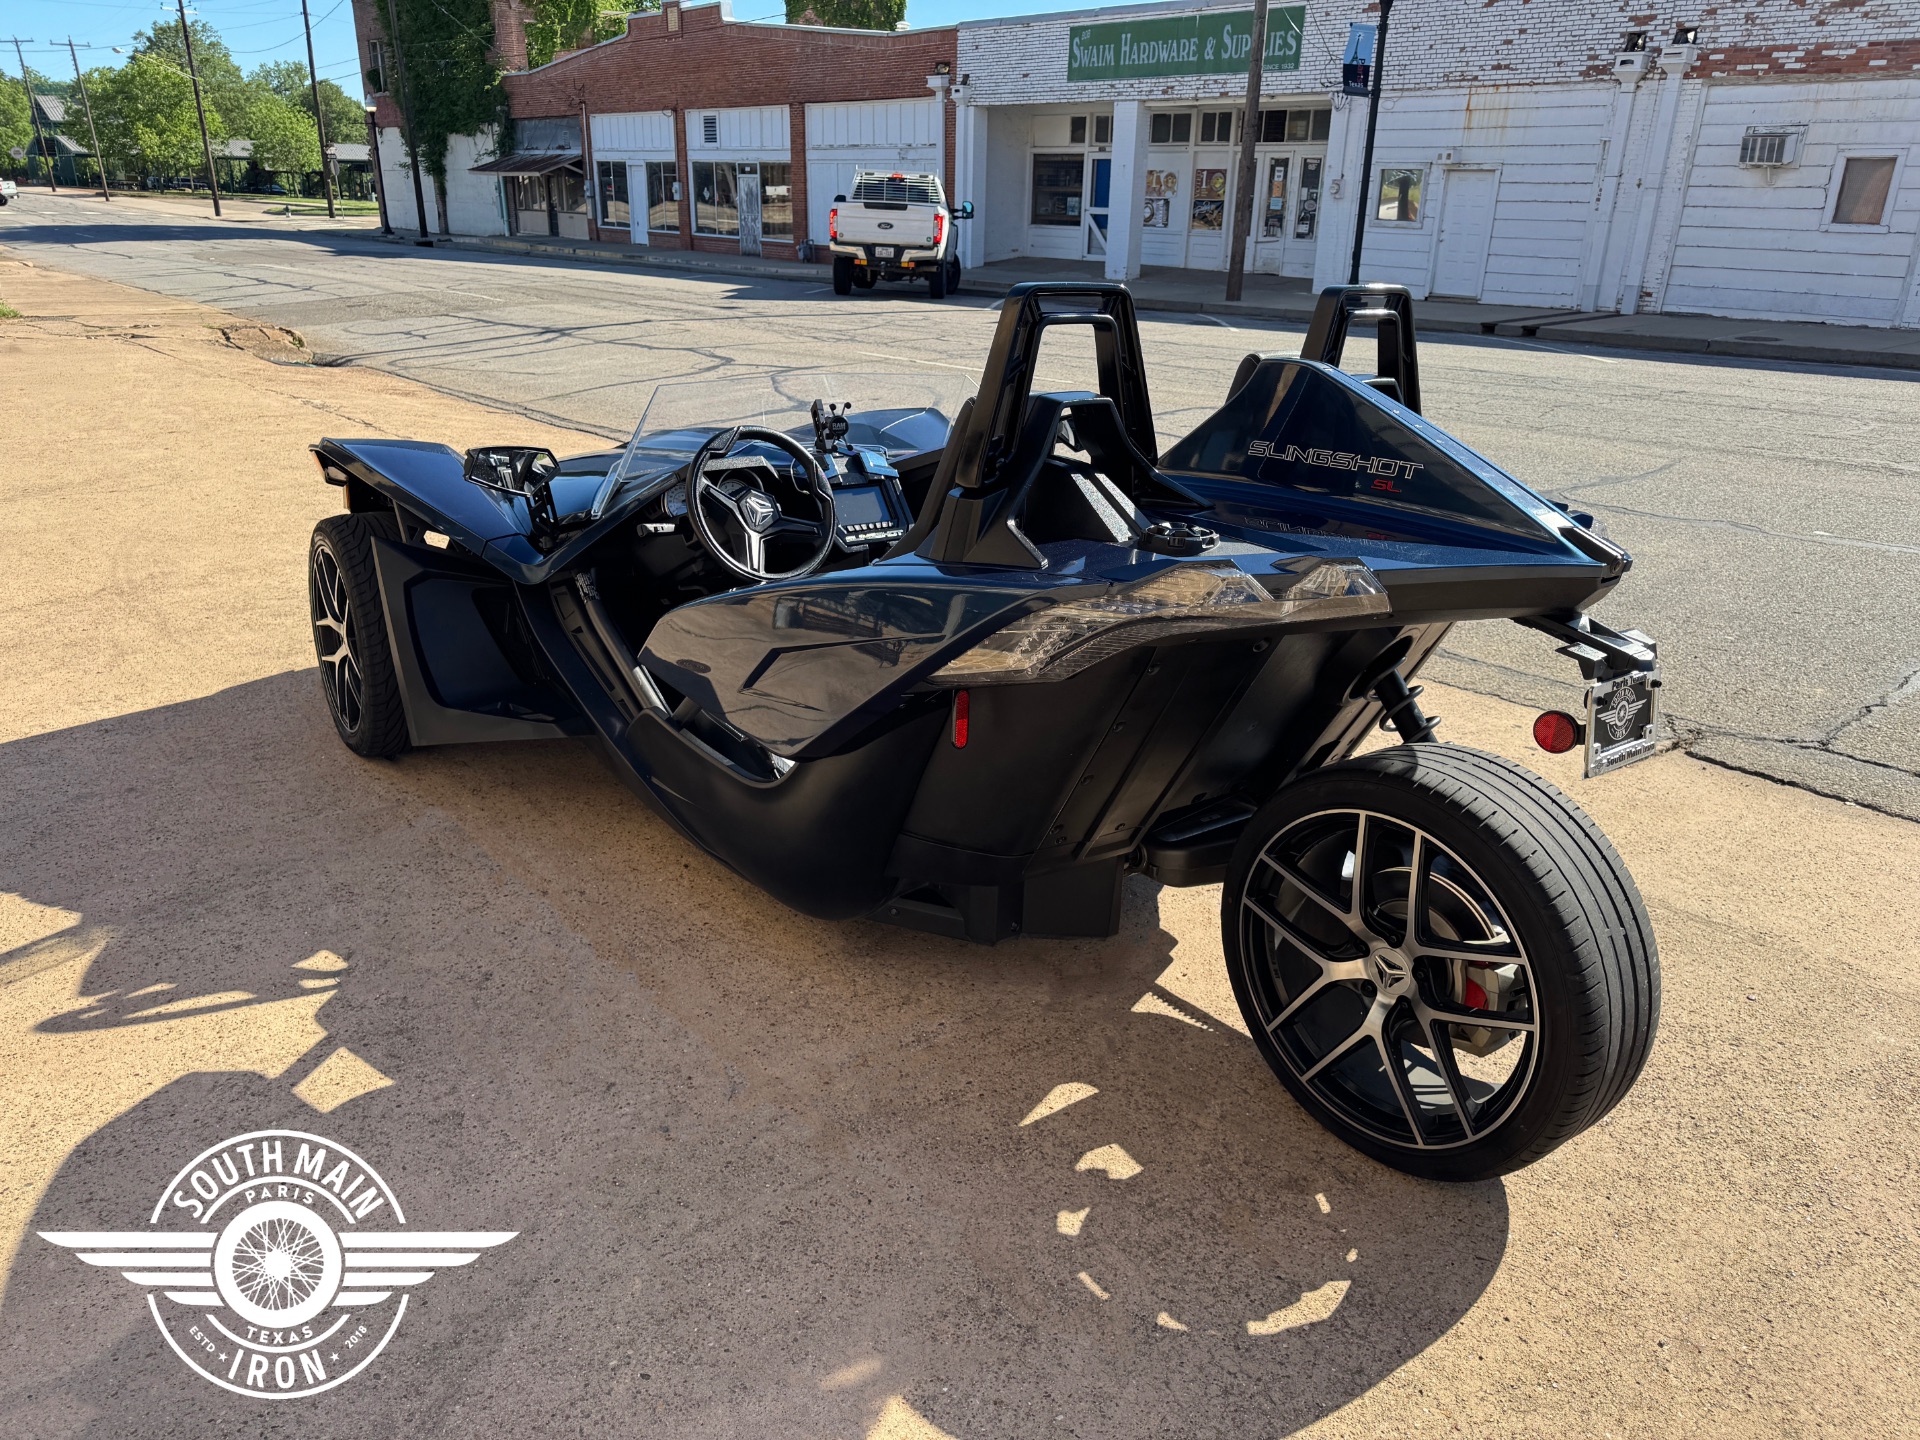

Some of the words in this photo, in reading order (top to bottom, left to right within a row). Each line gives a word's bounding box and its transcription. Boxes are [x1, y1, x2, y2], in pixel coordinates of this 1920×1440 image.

[1072, 36, 1115, 68] SWAIM
[1120, 33, 1199, 66] HARDWARE
[1204, 36, 1216, 60] &
[1221, 24, 1297, 59] SUPIES
[1348, 80, 1364, 88] Texas
[1248, 440, 1424, 479] SLINGSHOT
[1371, 479, 1402, 493] SL
[1612, 677, 1629, 690] Paris
[1606, 752, 1626, 767] South
[1626, 746, 1642, 760] Main
